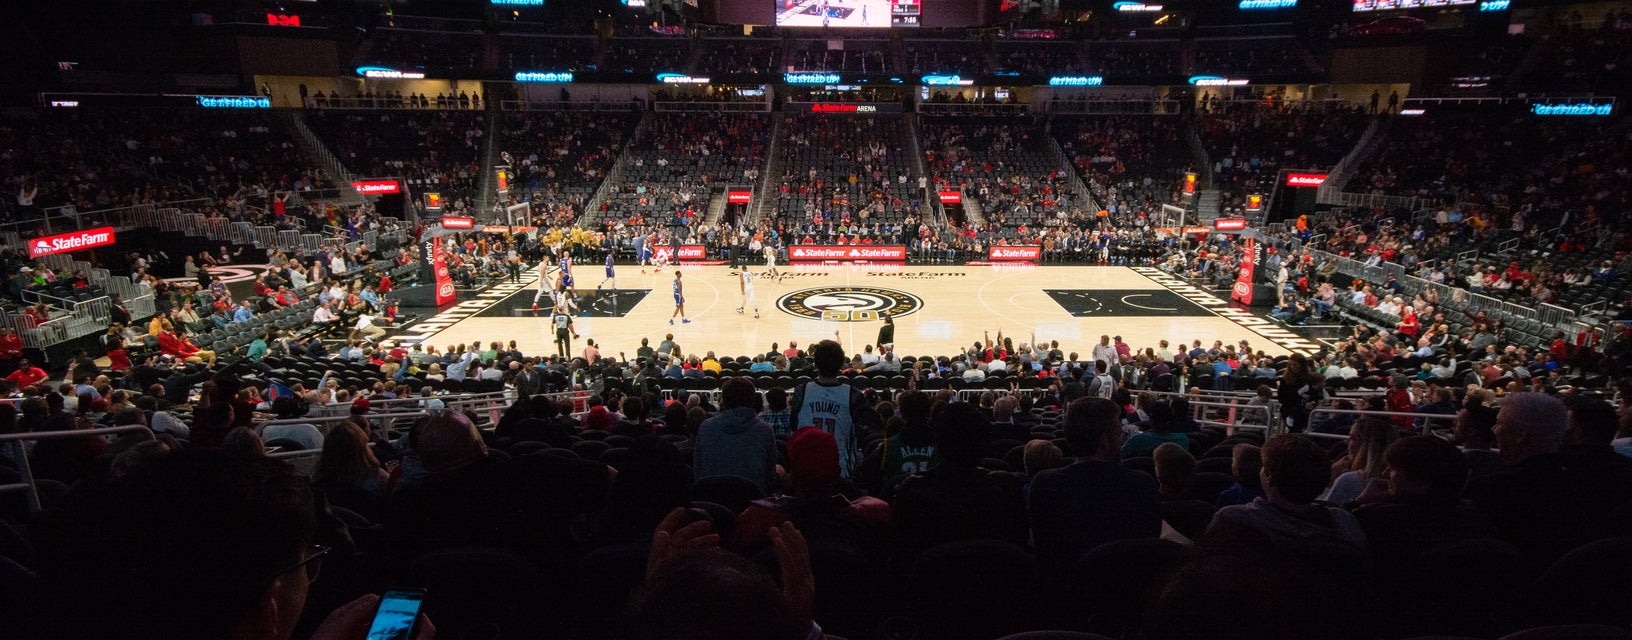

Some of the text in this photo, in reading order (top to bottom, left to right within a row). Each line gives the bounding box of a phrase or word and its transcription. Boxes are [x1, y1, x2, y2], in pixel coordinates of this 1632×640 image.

[225, 98, 257, 107] FIRED
[1559, 104, 1596, 114] FIRED
[52, 232, 108, 251] State Farm
[425, 241, 435, 265] xfinity
[805, 248, 845, 257] State Farm
[861, 248, 900, 257] State Farm
[1003, 249, 1036, 257] State Farm
[1253, 242, 1263, 266] xfinity
[809, 401, 840, 415] YOUNG
[901, 445, 935, 459] ALLEN
